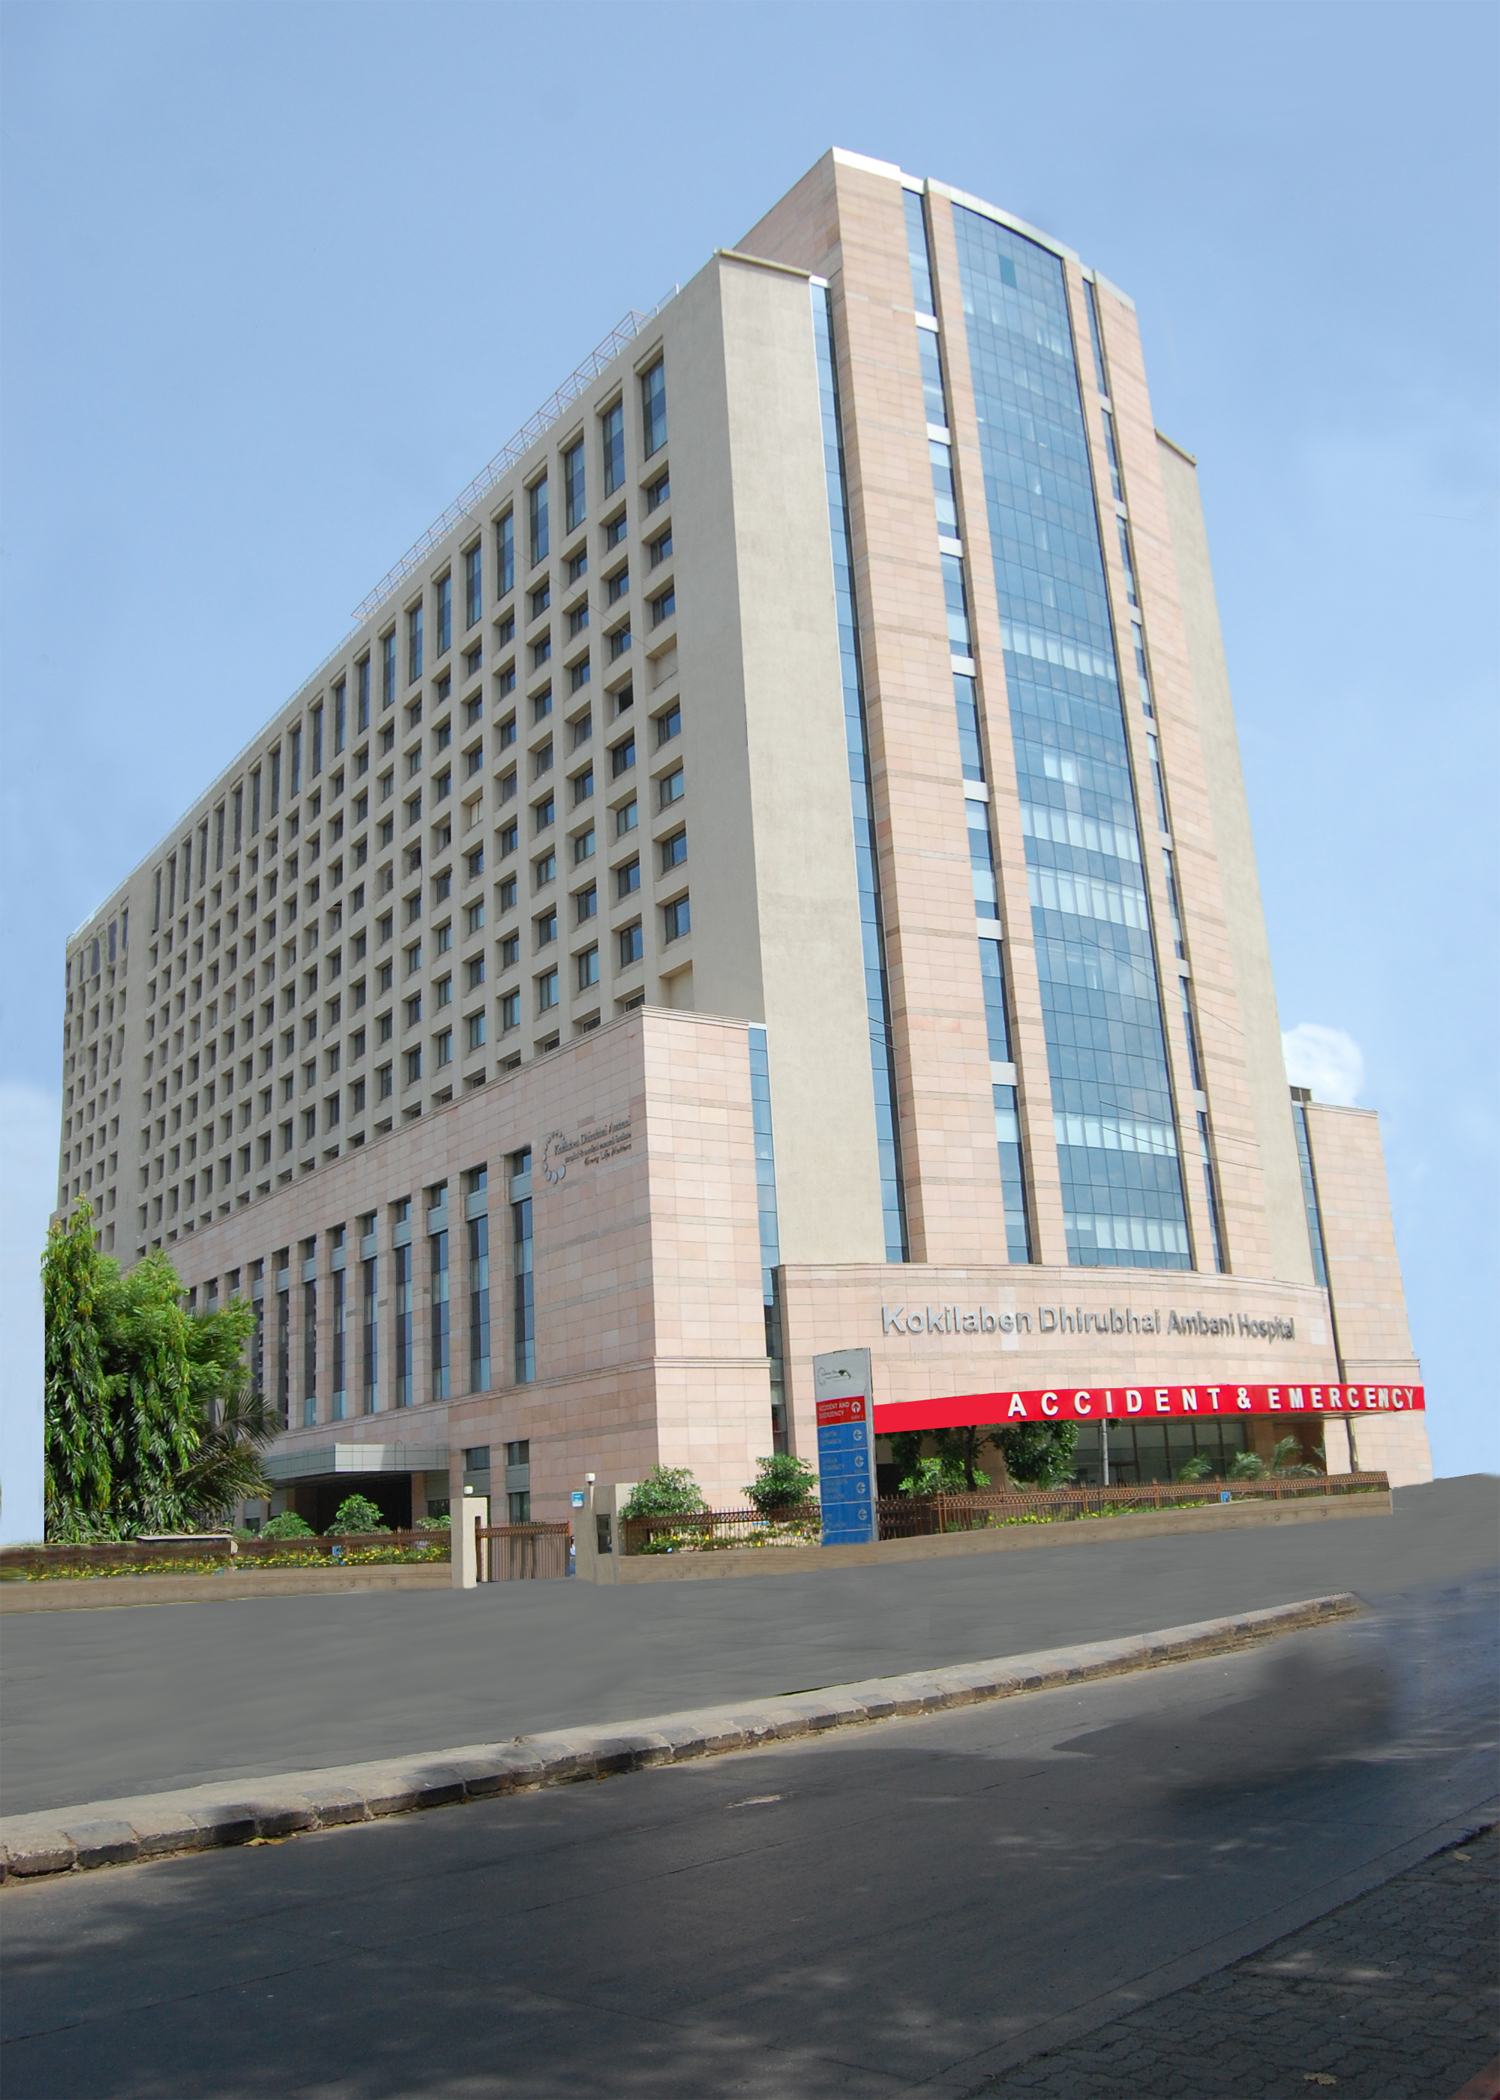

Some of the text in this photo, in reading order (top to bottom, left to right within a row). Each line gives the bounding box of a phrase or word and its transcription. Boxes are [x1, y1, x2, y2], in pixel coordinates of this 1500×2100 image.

[882, 1305, 1295, 1344] Kokilaben Dhirubhai Ambani Hospital
[1008, 1388, 1221, 1417] ACCIDENT
[1237, 1387, 1251, 1410] &
